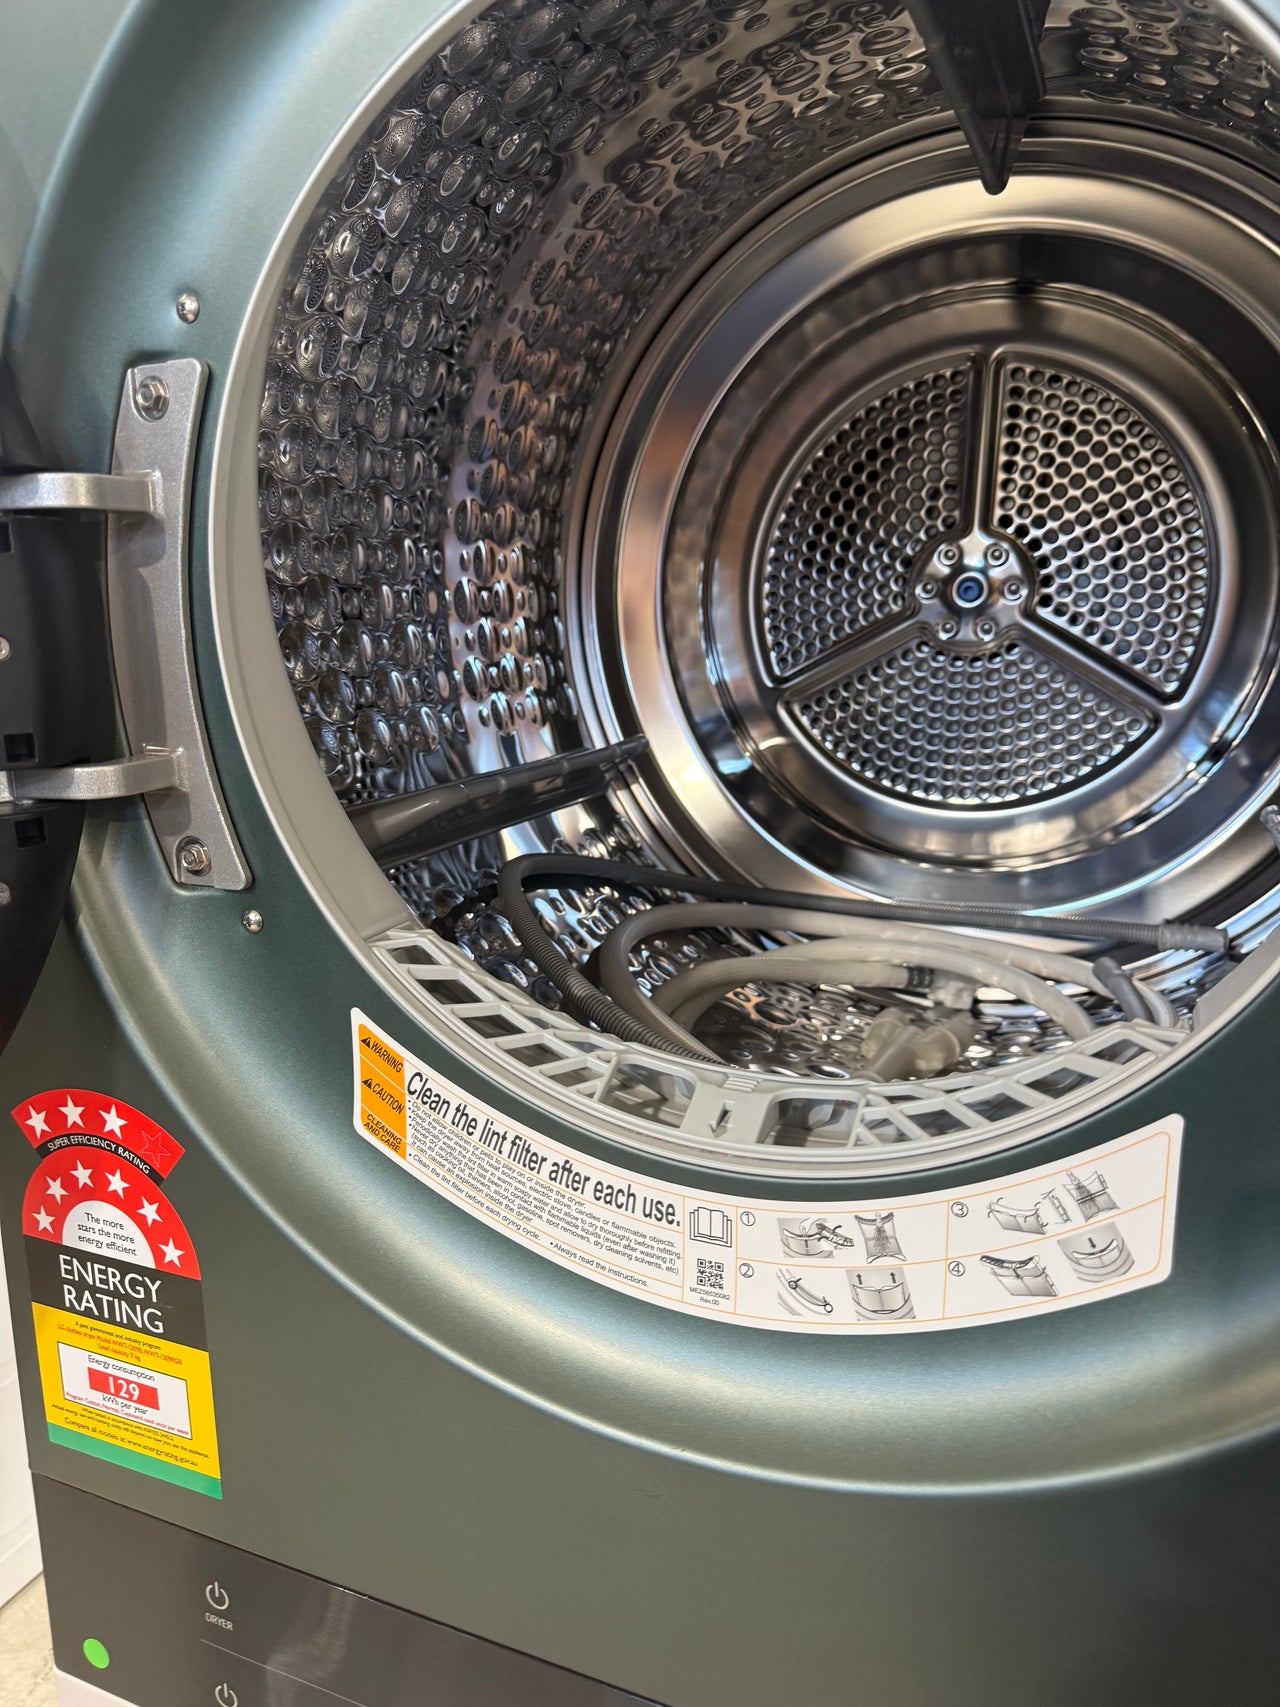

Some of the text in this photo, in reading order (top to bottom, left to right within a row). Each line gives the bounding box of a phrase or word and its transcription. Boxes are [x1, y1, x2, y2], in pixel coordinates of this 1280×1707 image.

[370, 1040, 404, 1073] WARNING
[371, 1082, 405, 1115] CAUTION
[363, 1121, 401, 1153] AND CARE
[366, 1113, 403, 1145] CLEANING
[47, 1135, 150, 1174] SUPER EFFICIENCY RATING
[406, 1071, 681, 1227] Clean the lint filter after each use.
[411, 1101, 421, 1111] Do
[421, 1109, 432, 1119] not
[431, 1117, 448, 1130] allow
[448, 1129, 472, 1146] children
[480, 1149, 494, 1161] pets
[494, 1157, 502, 1165] to
[501, 1162, 516, 1174] play
[516, 1171, 526, 1179] on
[534, 1179, 554, 1194] inside
[555, 1190, 566, 1200] the
[567, 1196, 587, 1209] dryer.
[411, 1108, 427, 1124] Keep
[427, 1120, 438, 1131] the
[437, 1129, 455, 1142] dryer
[453, 1140, 471, 1154] away
[470, 1150, 486, 1163] from
[486, 1160, 501, 1172] heat
[500, 1170, 528, 1189] sources,
[529, 1185, 553, 1201] electric
[553, 1198, 573, 1212] stove,
[574, 1207, 601, 1223] candles
[611, 1221, 648, 1240] flammable
[648, 1235, 677, 1249] objects.
[411, 1139, 534, 1223] It can cause an explosion inside the dryer
[411, 1116, 683, 1260] Periodically wash the lint filter in warm soapy water and allow to dry thoroughly before refitting.
[411, 1124, 677, 1267] Never dry anything that has been in contact with flammable liquids (even after washing it)
[84, 1212, 125, 1231] The more
[411, 1132, 679, 1276] (such as cooking oil, thinners, alcohol, gasoline, spot removers, dry cleaning solvents, etc)
[413, 1154, 649, 1288] Clean the lint filter before each drying cycle. Always read the instructions.
[77, 1223, 135, 1244] stars the more
[77, 1235, 137, 1256] energy efficient
[59, 1254, 162, 1303] ENERGY
[63, 1285, 164, 1334] RATING
[88, 1354, 156, 1381] Energy consumption
[107, 1376, 140, 1401] 129
[205, 1612, 233, 1631] DRYER
